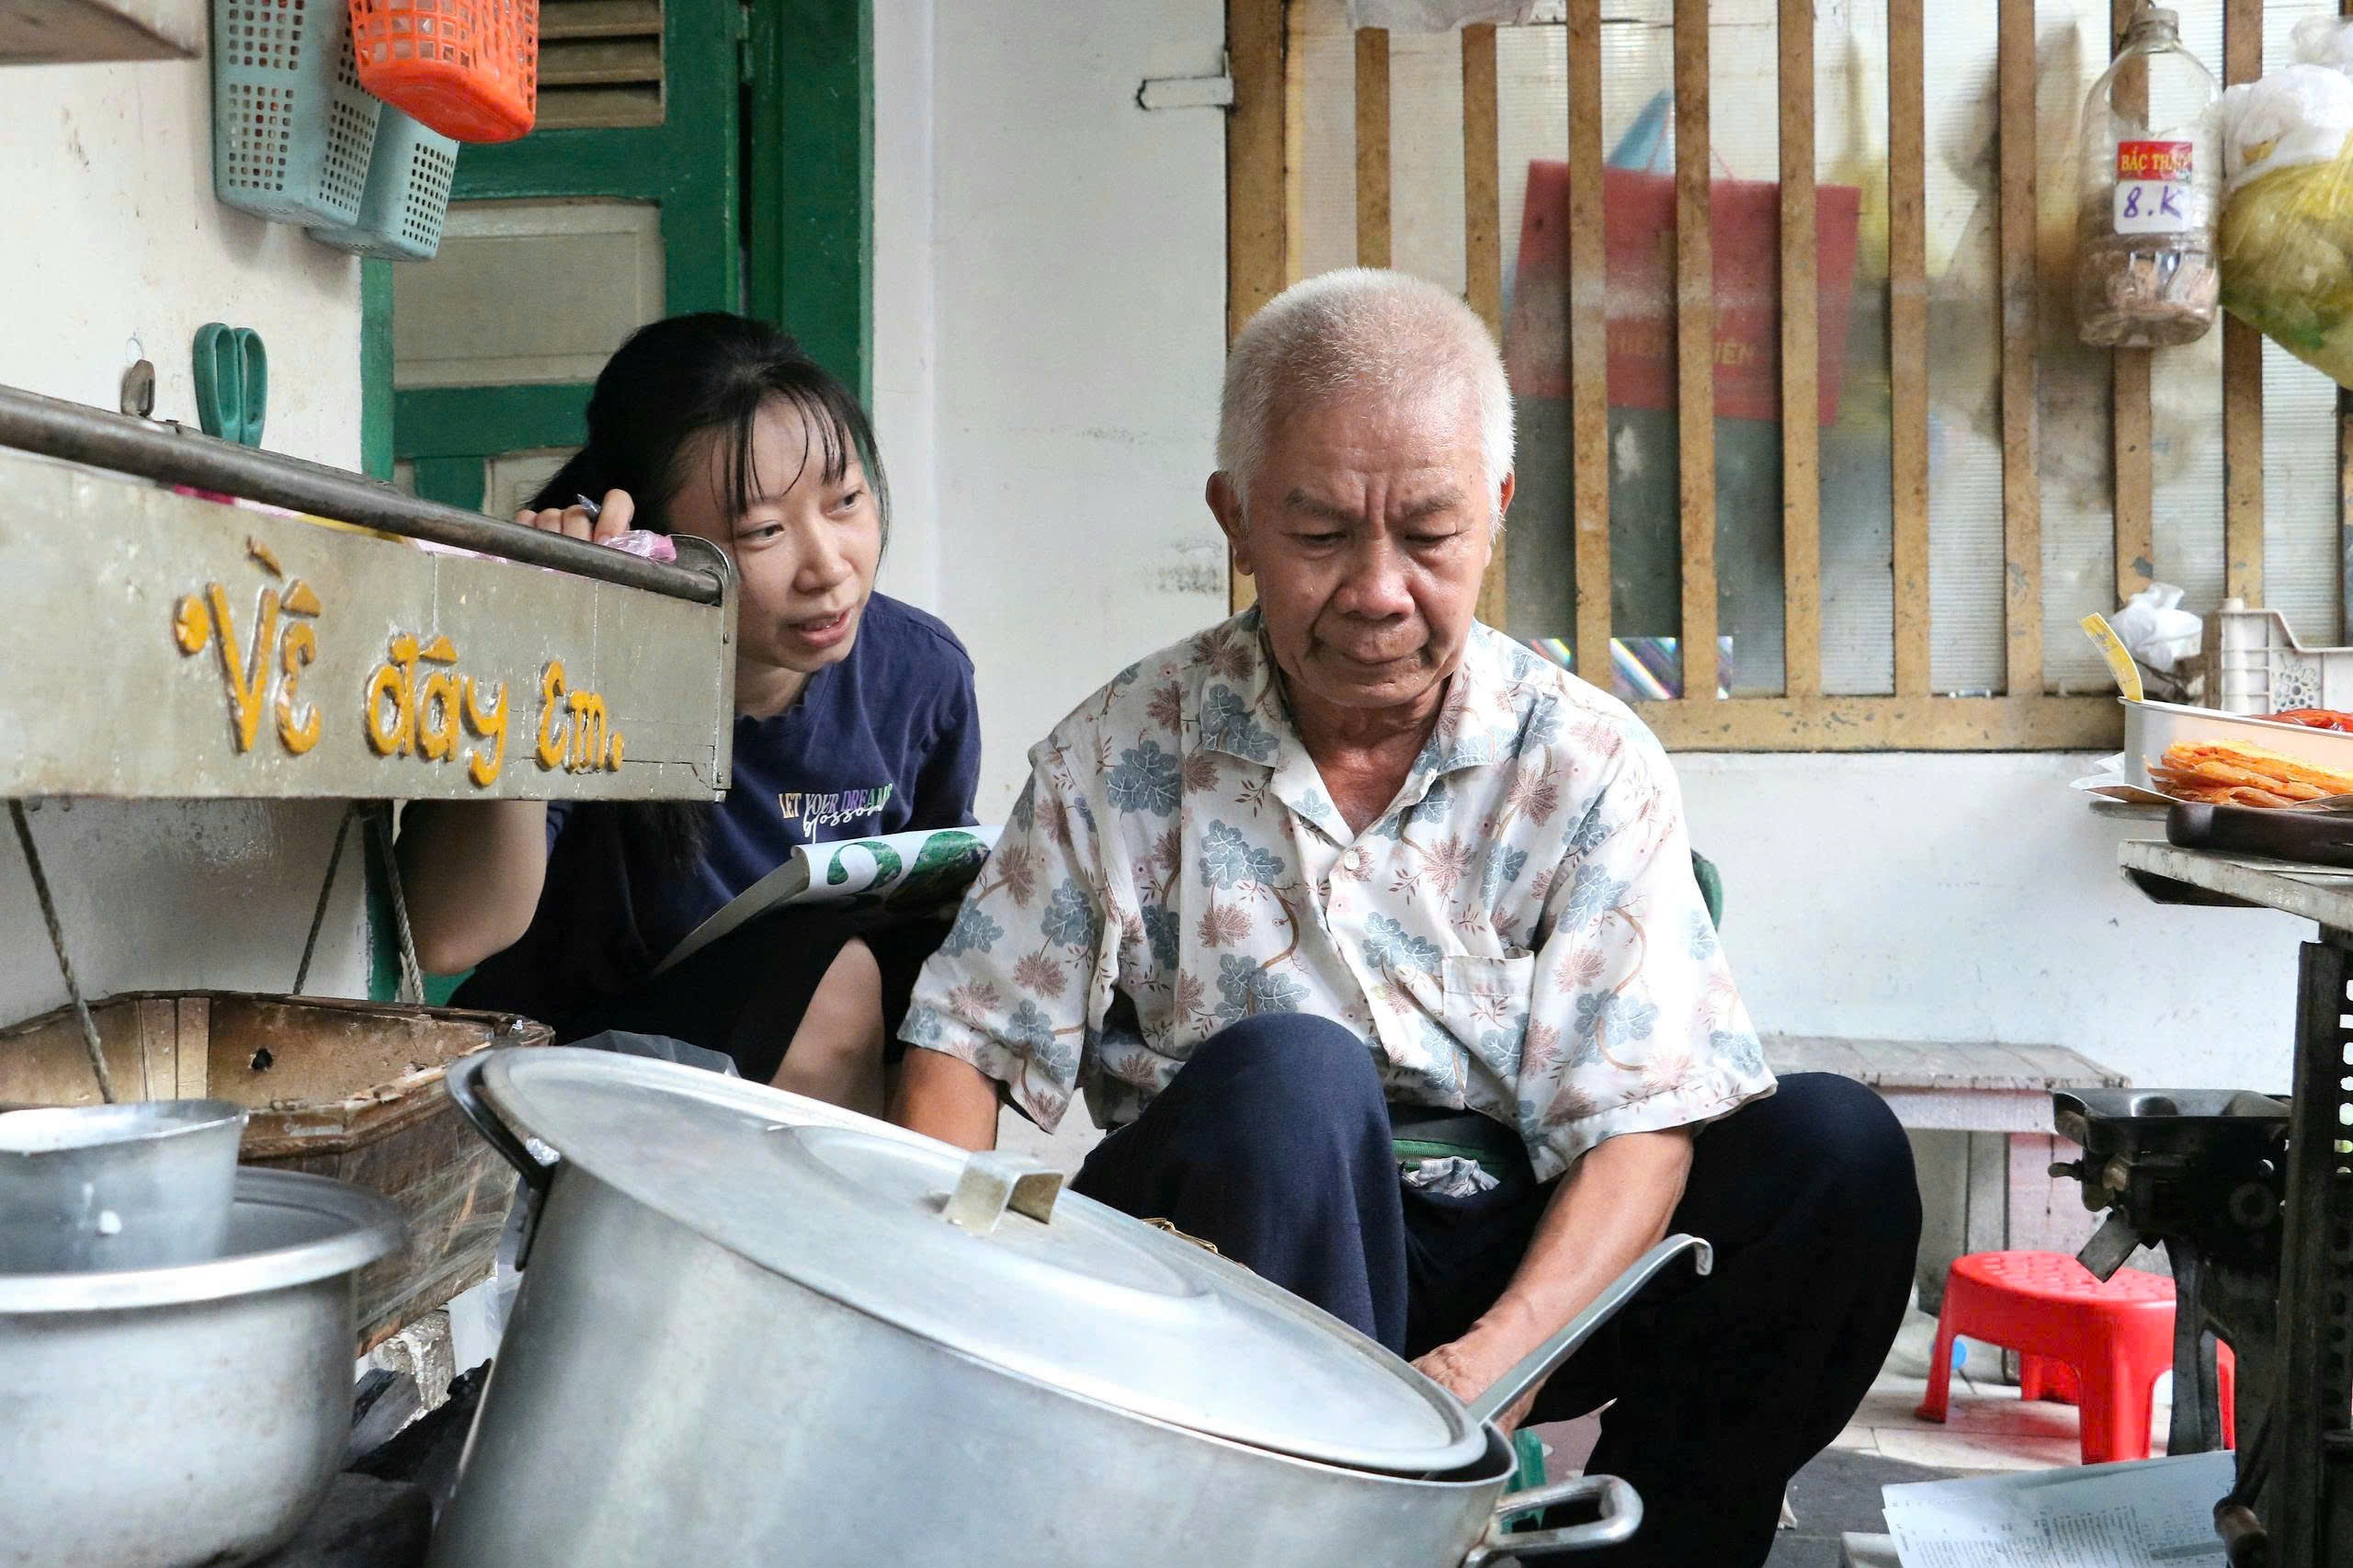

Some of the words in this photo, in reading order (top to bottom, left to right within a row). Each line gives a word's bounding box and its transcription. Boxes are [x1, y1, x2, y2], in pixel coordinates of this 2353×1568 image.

[174, 536, 322, 756] Về
[368, 631, 509, 788] đây
[779, 792, 801, 818] LET
[805, 793, 839, 815] YOUR
